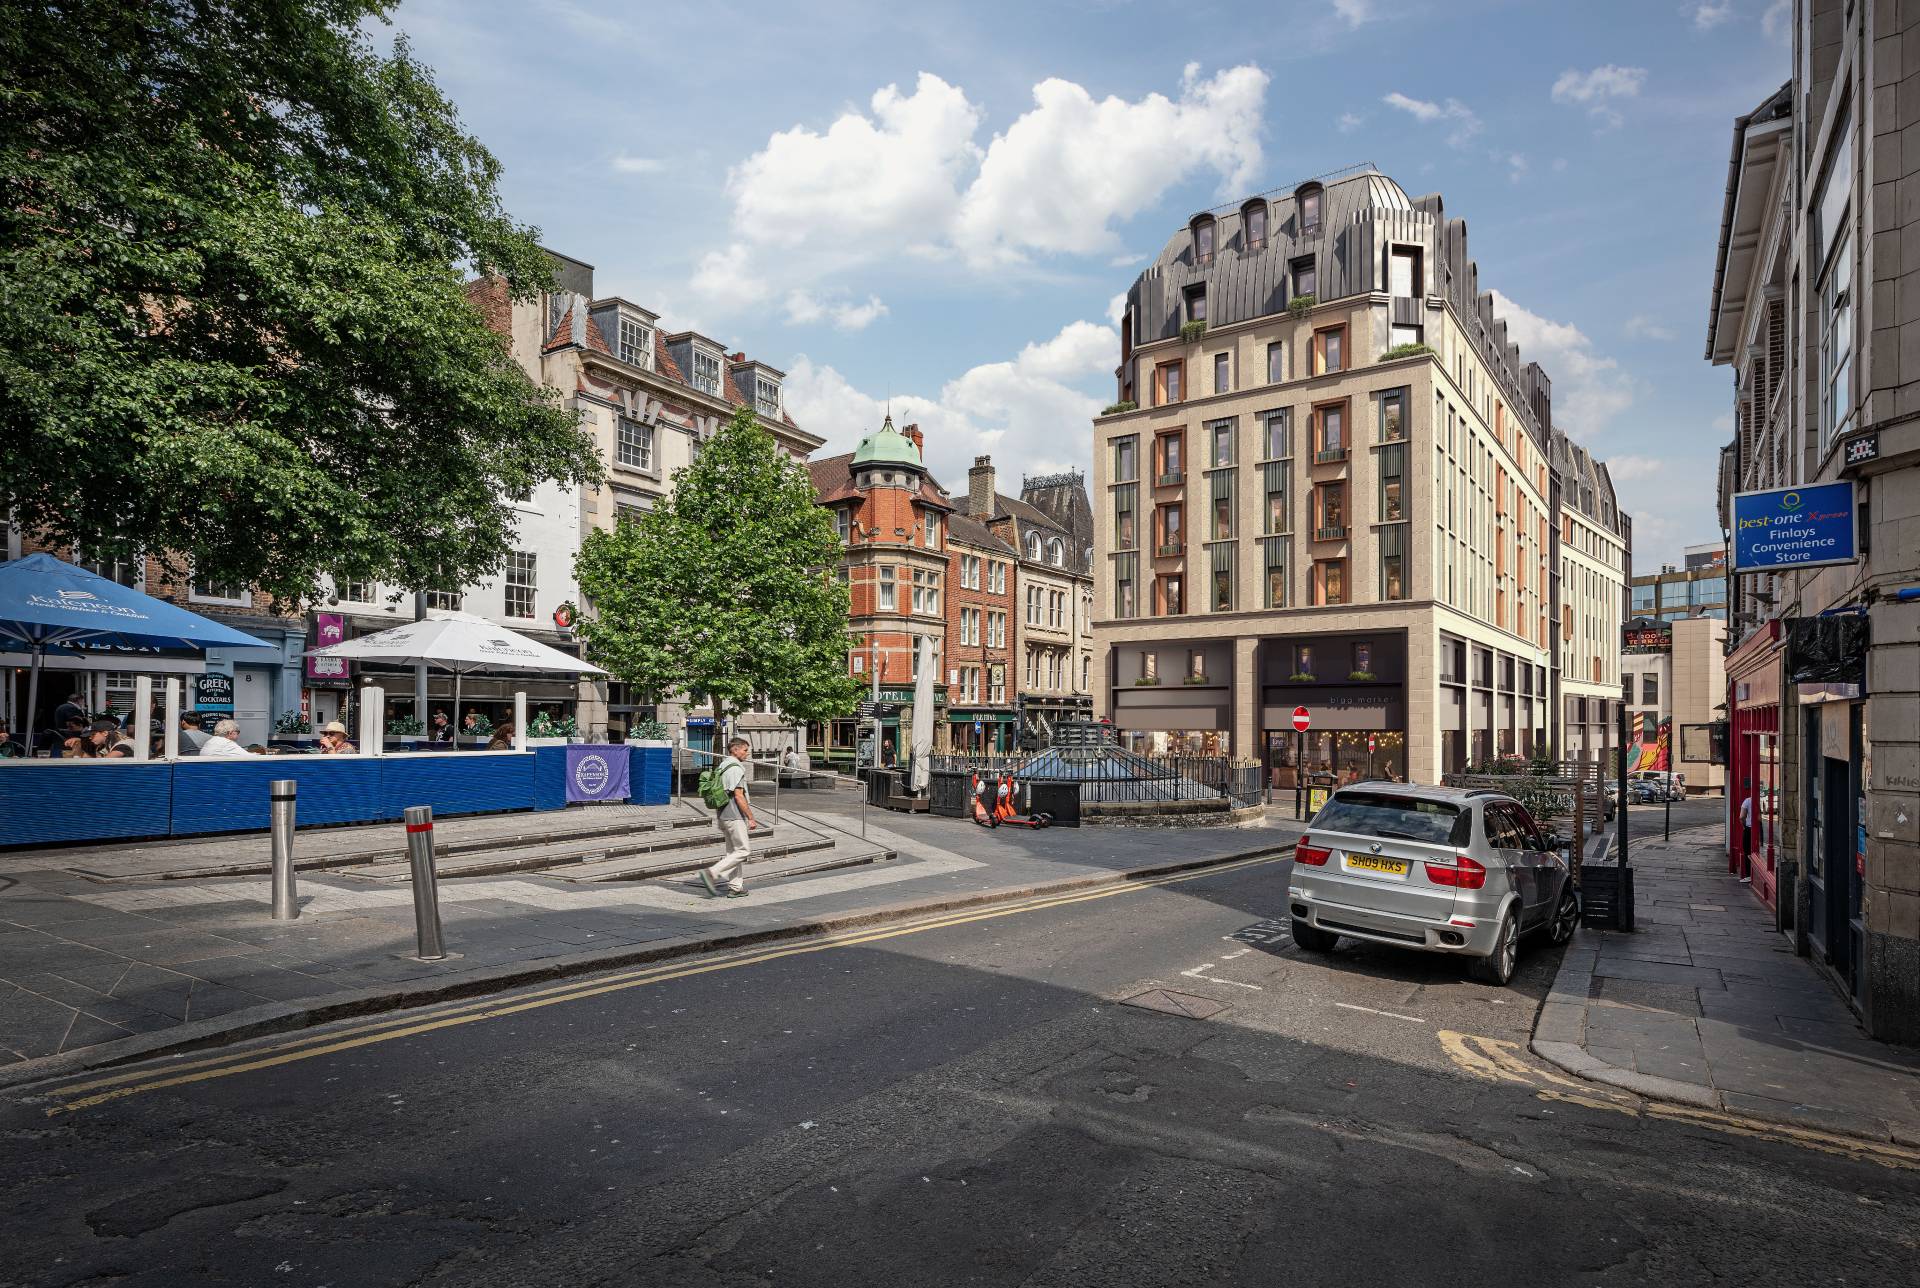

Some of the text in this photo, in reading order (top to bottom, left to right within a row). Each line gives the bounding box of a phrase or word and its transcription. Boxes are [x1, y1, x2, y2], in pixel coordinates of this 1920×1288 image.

[1739, 513, 1802, 529] best-one
[1770, 528, 1816, 540] Finlays
[1752, 538, 1835, 553] Convenience
[1776, 552, 1811, 563] Store
[199, 678, 231, 691] GREEK
[1352, 855, 1402, 872] SH09 HXS
